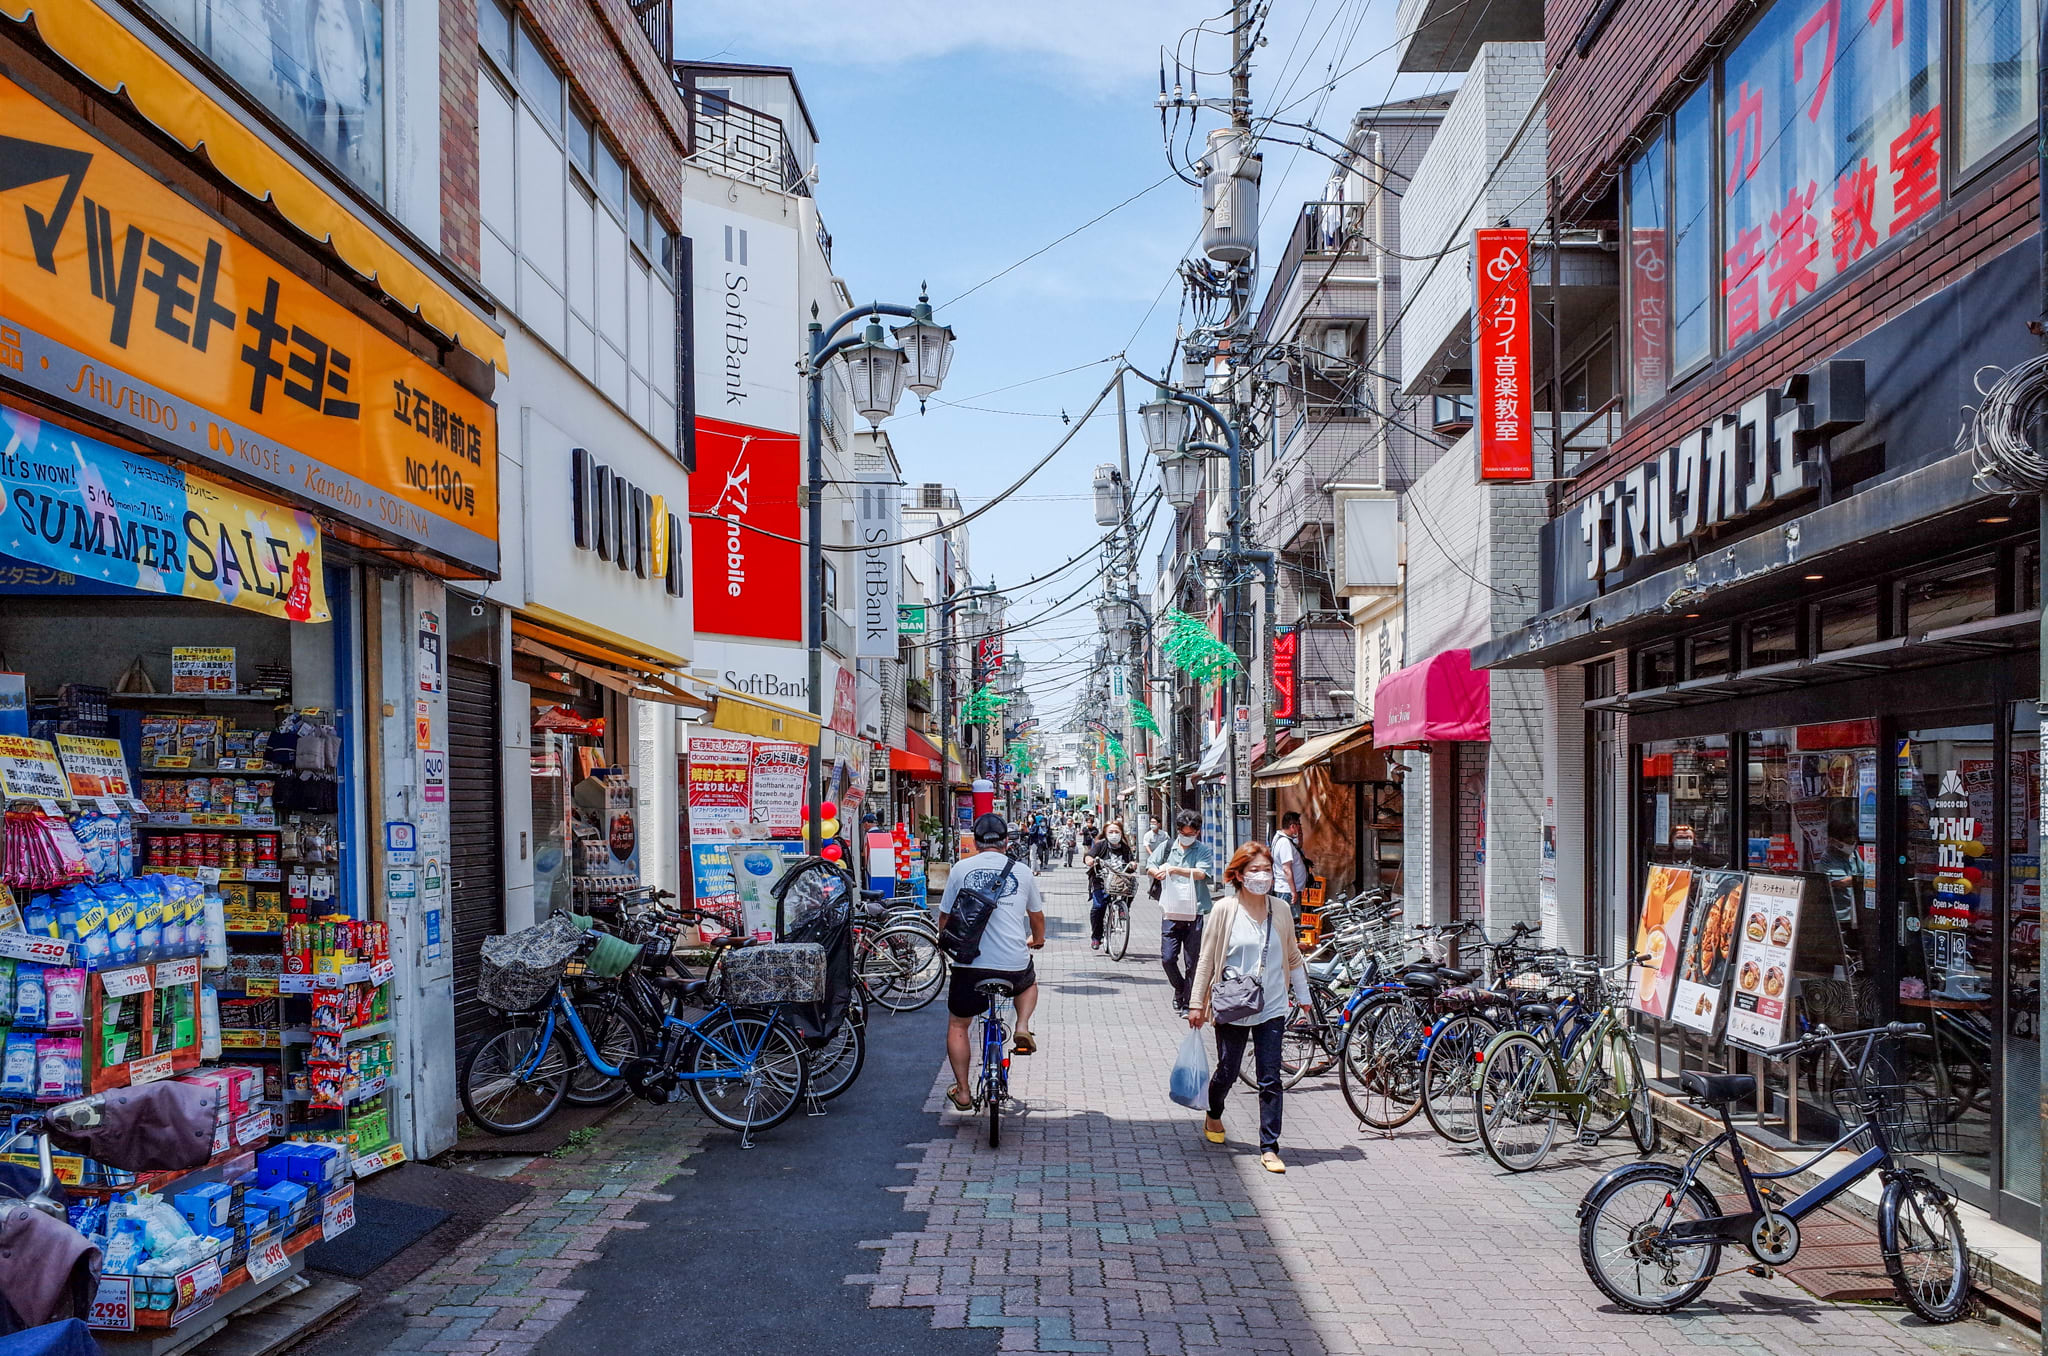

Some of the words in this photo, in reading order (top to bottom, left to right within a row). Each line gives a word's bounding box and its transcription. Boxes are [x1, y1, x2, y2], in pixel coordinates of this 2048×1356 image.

[1722, 104, 1941, 350] 音楽教室
[0, 134, 360, 420] マツモトキヨシ
[725, 272, 748, 406] SoftBank
[1494, 295, 1519, 442] カワイ音楽教室
[66, 363, 179, 432] SHISEIDO
[393, 379, 482, 468] 立石駅前店
[36, 461, 77, 485] wow!
[239, 438, 281, 476] KOSÉ
[304, 462, 363, 511] Kanebo
[1581, 375, 1817, 582] サンマルクカフェ
[379, 497, 430, 539] SOFINA
[12, 488, 184, 574] SUMMER
[183, 510, 291, 602] SALE
[864, 527, 889, 642] SoftBank
[725, 670, 810, 698] SoftBank
[426, 759, 442, 778] QUO
[691, 768, 746, 782] 解約金不要
[755, 751, 806, 767] メアド引継ぎ
[1929, 817, 1975, 842] サンマルク
[1938, 844, 1965, 869] カフェ
[1933, 898, 1947, 910] Open
[1953, 900, 1970, 911] Close
[95, 1302, 127, 1319] 298
